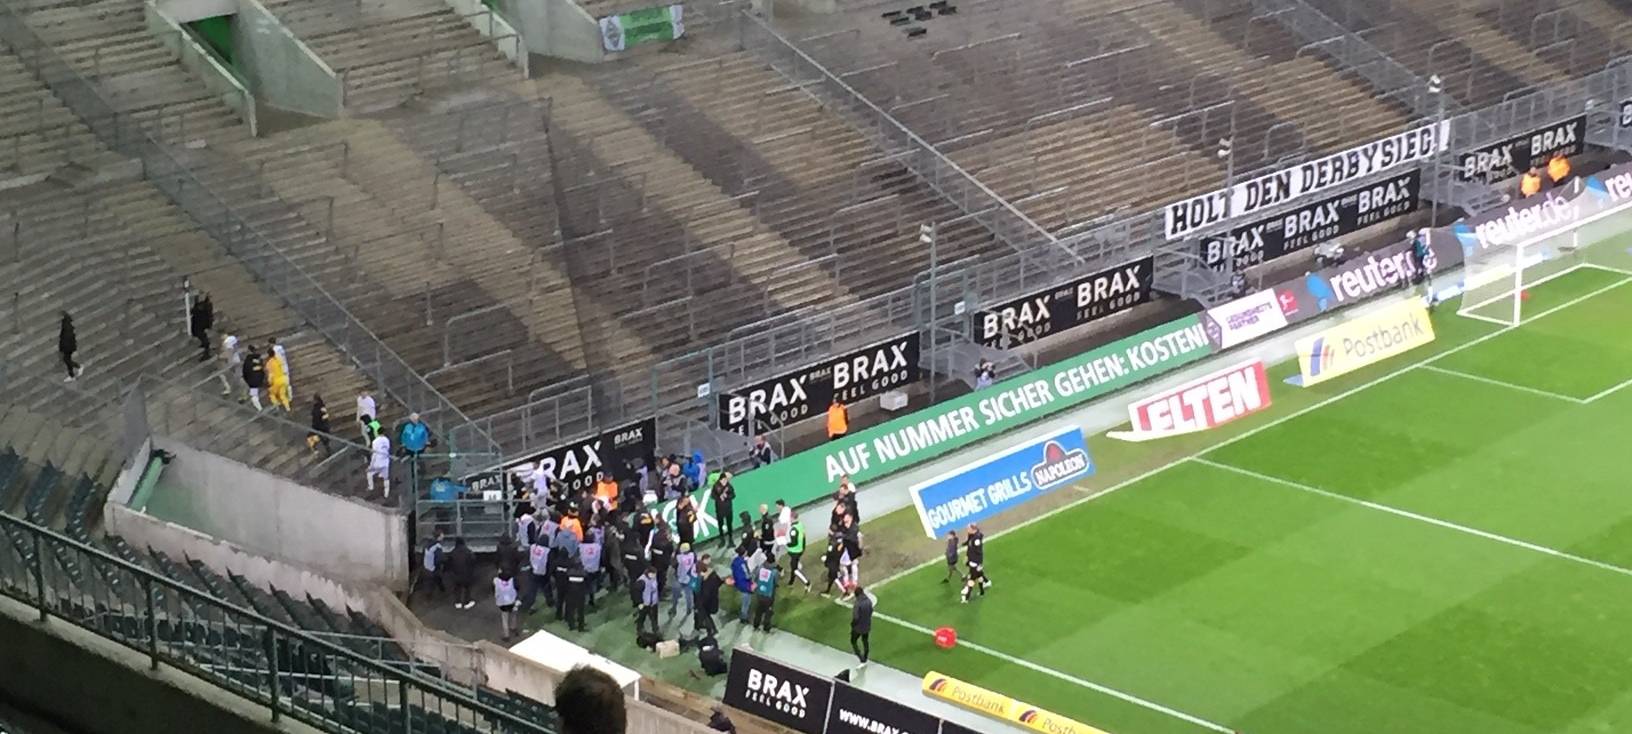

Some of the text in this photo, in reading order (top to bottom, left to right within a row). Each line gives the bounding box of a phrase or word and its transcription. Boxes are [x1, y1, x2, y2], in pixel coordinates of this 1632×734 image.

[1531, 122, 1577, 156] BRAX
[1464, 145, 1513, 178] BRAX
[1171, 193, 1234, 235] HOLT
[1244, 173, 1291, 212] DEN
[1358, 176, 1411, 214] BRAX
[1284, 199, 1340, 238] BRAX
[1077, 265, 1140, 308] BRAX
[984, 295, 1050, 339] BRAX
[1343, 315, 1424, 358] Postbank
[833, 341, 907, 389] BRAX
[872, 370, 908, 390] GOOD
[729, 375, 807, 424] BRAX
[770, 404, 808, 425] GOOD
[1146, 367, 1262, 431] ELTEN
[614, 427, 643, 445] BRAX
[825, 442, 872, 483] AUF
[873, 405, 979, 464] NUMMER
[979, 380, 1053, 425] SICHER
[1055, 357, 1130, 397] GEHEN:
[526, 440, 602, 481] RAX
[1035, 453, 1086, 486] NAPOLEON
[928, 471, 1032, 529] GOURMET GRILLS
[748, 668, 809, 708] BRAX
[952, 686, 1004, 713] Postbank
[776, 701, 805, 718] GOOD
